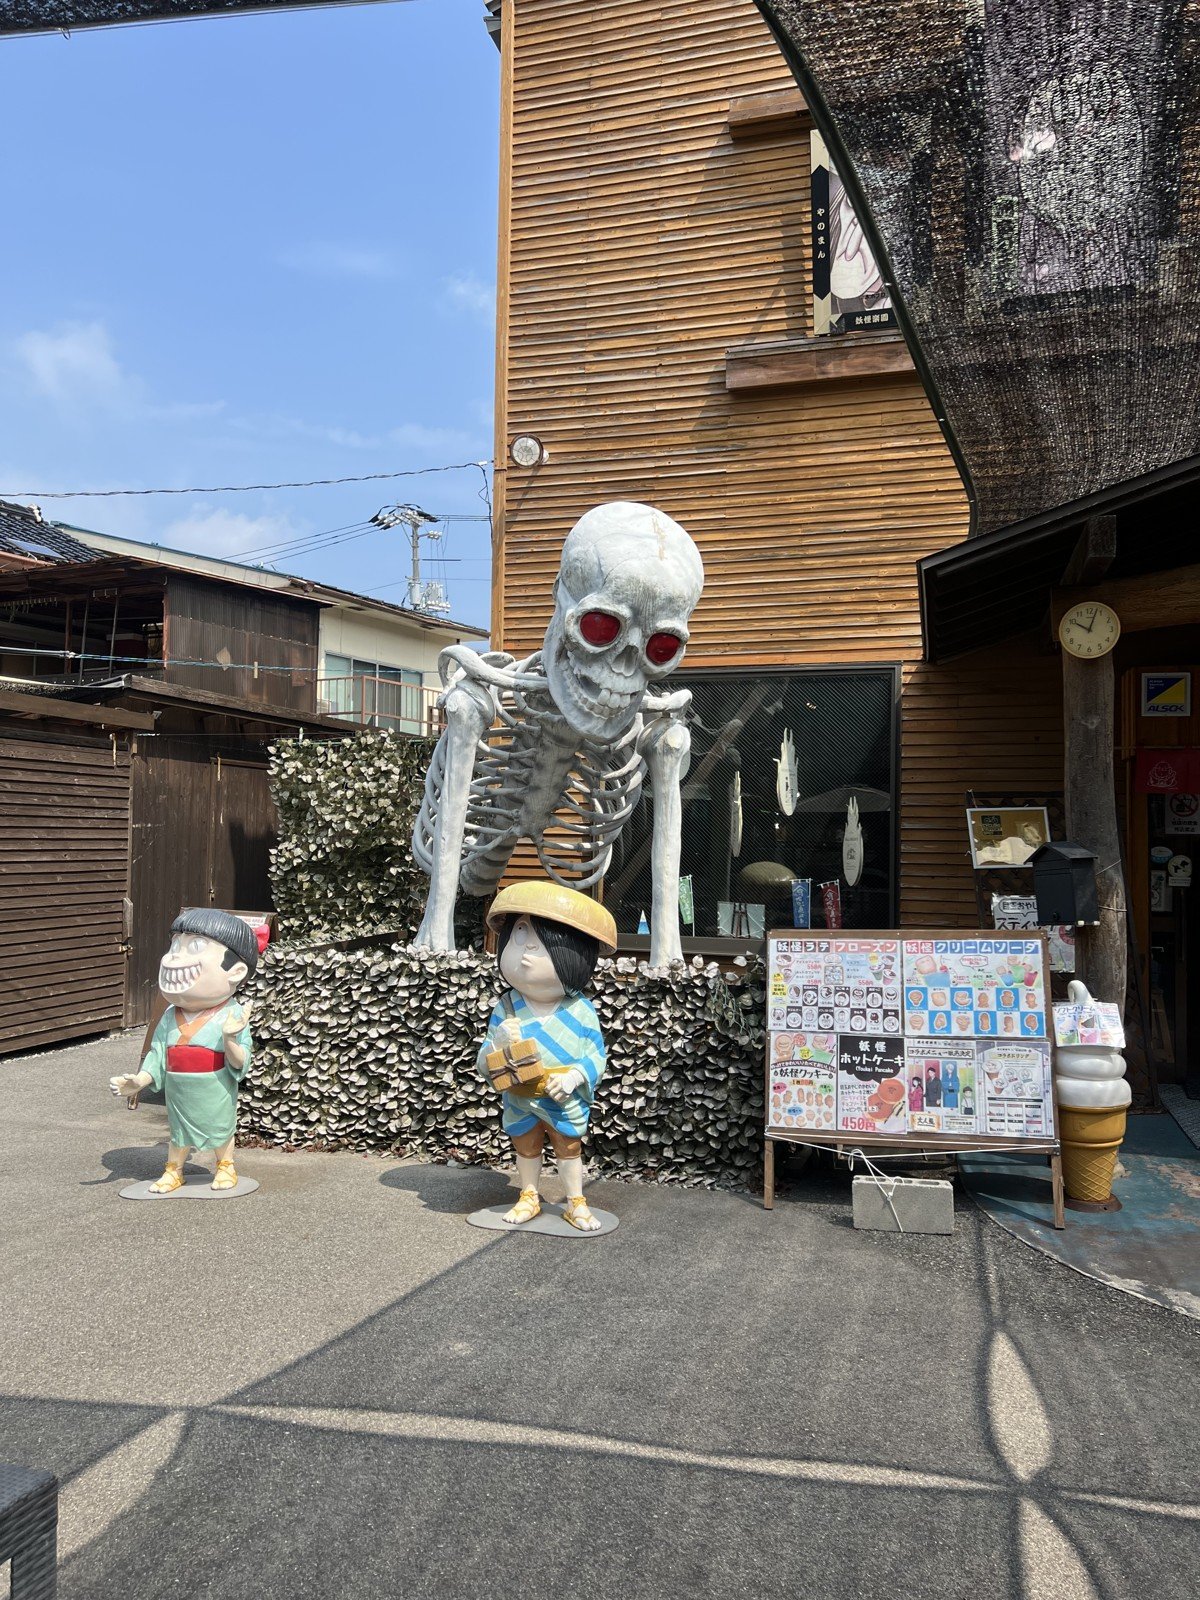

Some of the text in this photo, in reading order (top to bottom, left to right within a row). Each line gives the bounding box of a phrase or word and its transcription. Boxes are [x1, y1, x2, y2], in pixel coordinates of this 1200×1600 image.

[816, 207, 826, 260] やのまん
[855, 312, 889, 325] 妖怪楽園
[1086, 607, 1094, 615] 12
[1106, 616, 1111, 624] 2
[1065, 627, 1071, 635] 9
[1109, 625, 1114, 633] 3
[1069, 637, 1074, 645] 8
[1077, 643, 1082, 651] 7
[1097, 643, 1103, 651] 5
[1147, 704, 1185, 713] ALSOK
[777, 941, 897, 953] 妖怪ラテ フローズン
[906, 942, 1038, 953] 妖怪クリームソーダ
[858, 1040, 887, 1053] 妖怪
[840, 1053, 905, 1067] ホットケーキ
[779, 1068, 829, 1079] 妖怪クッキー
[841, 1116, 876, 1131] 450円
